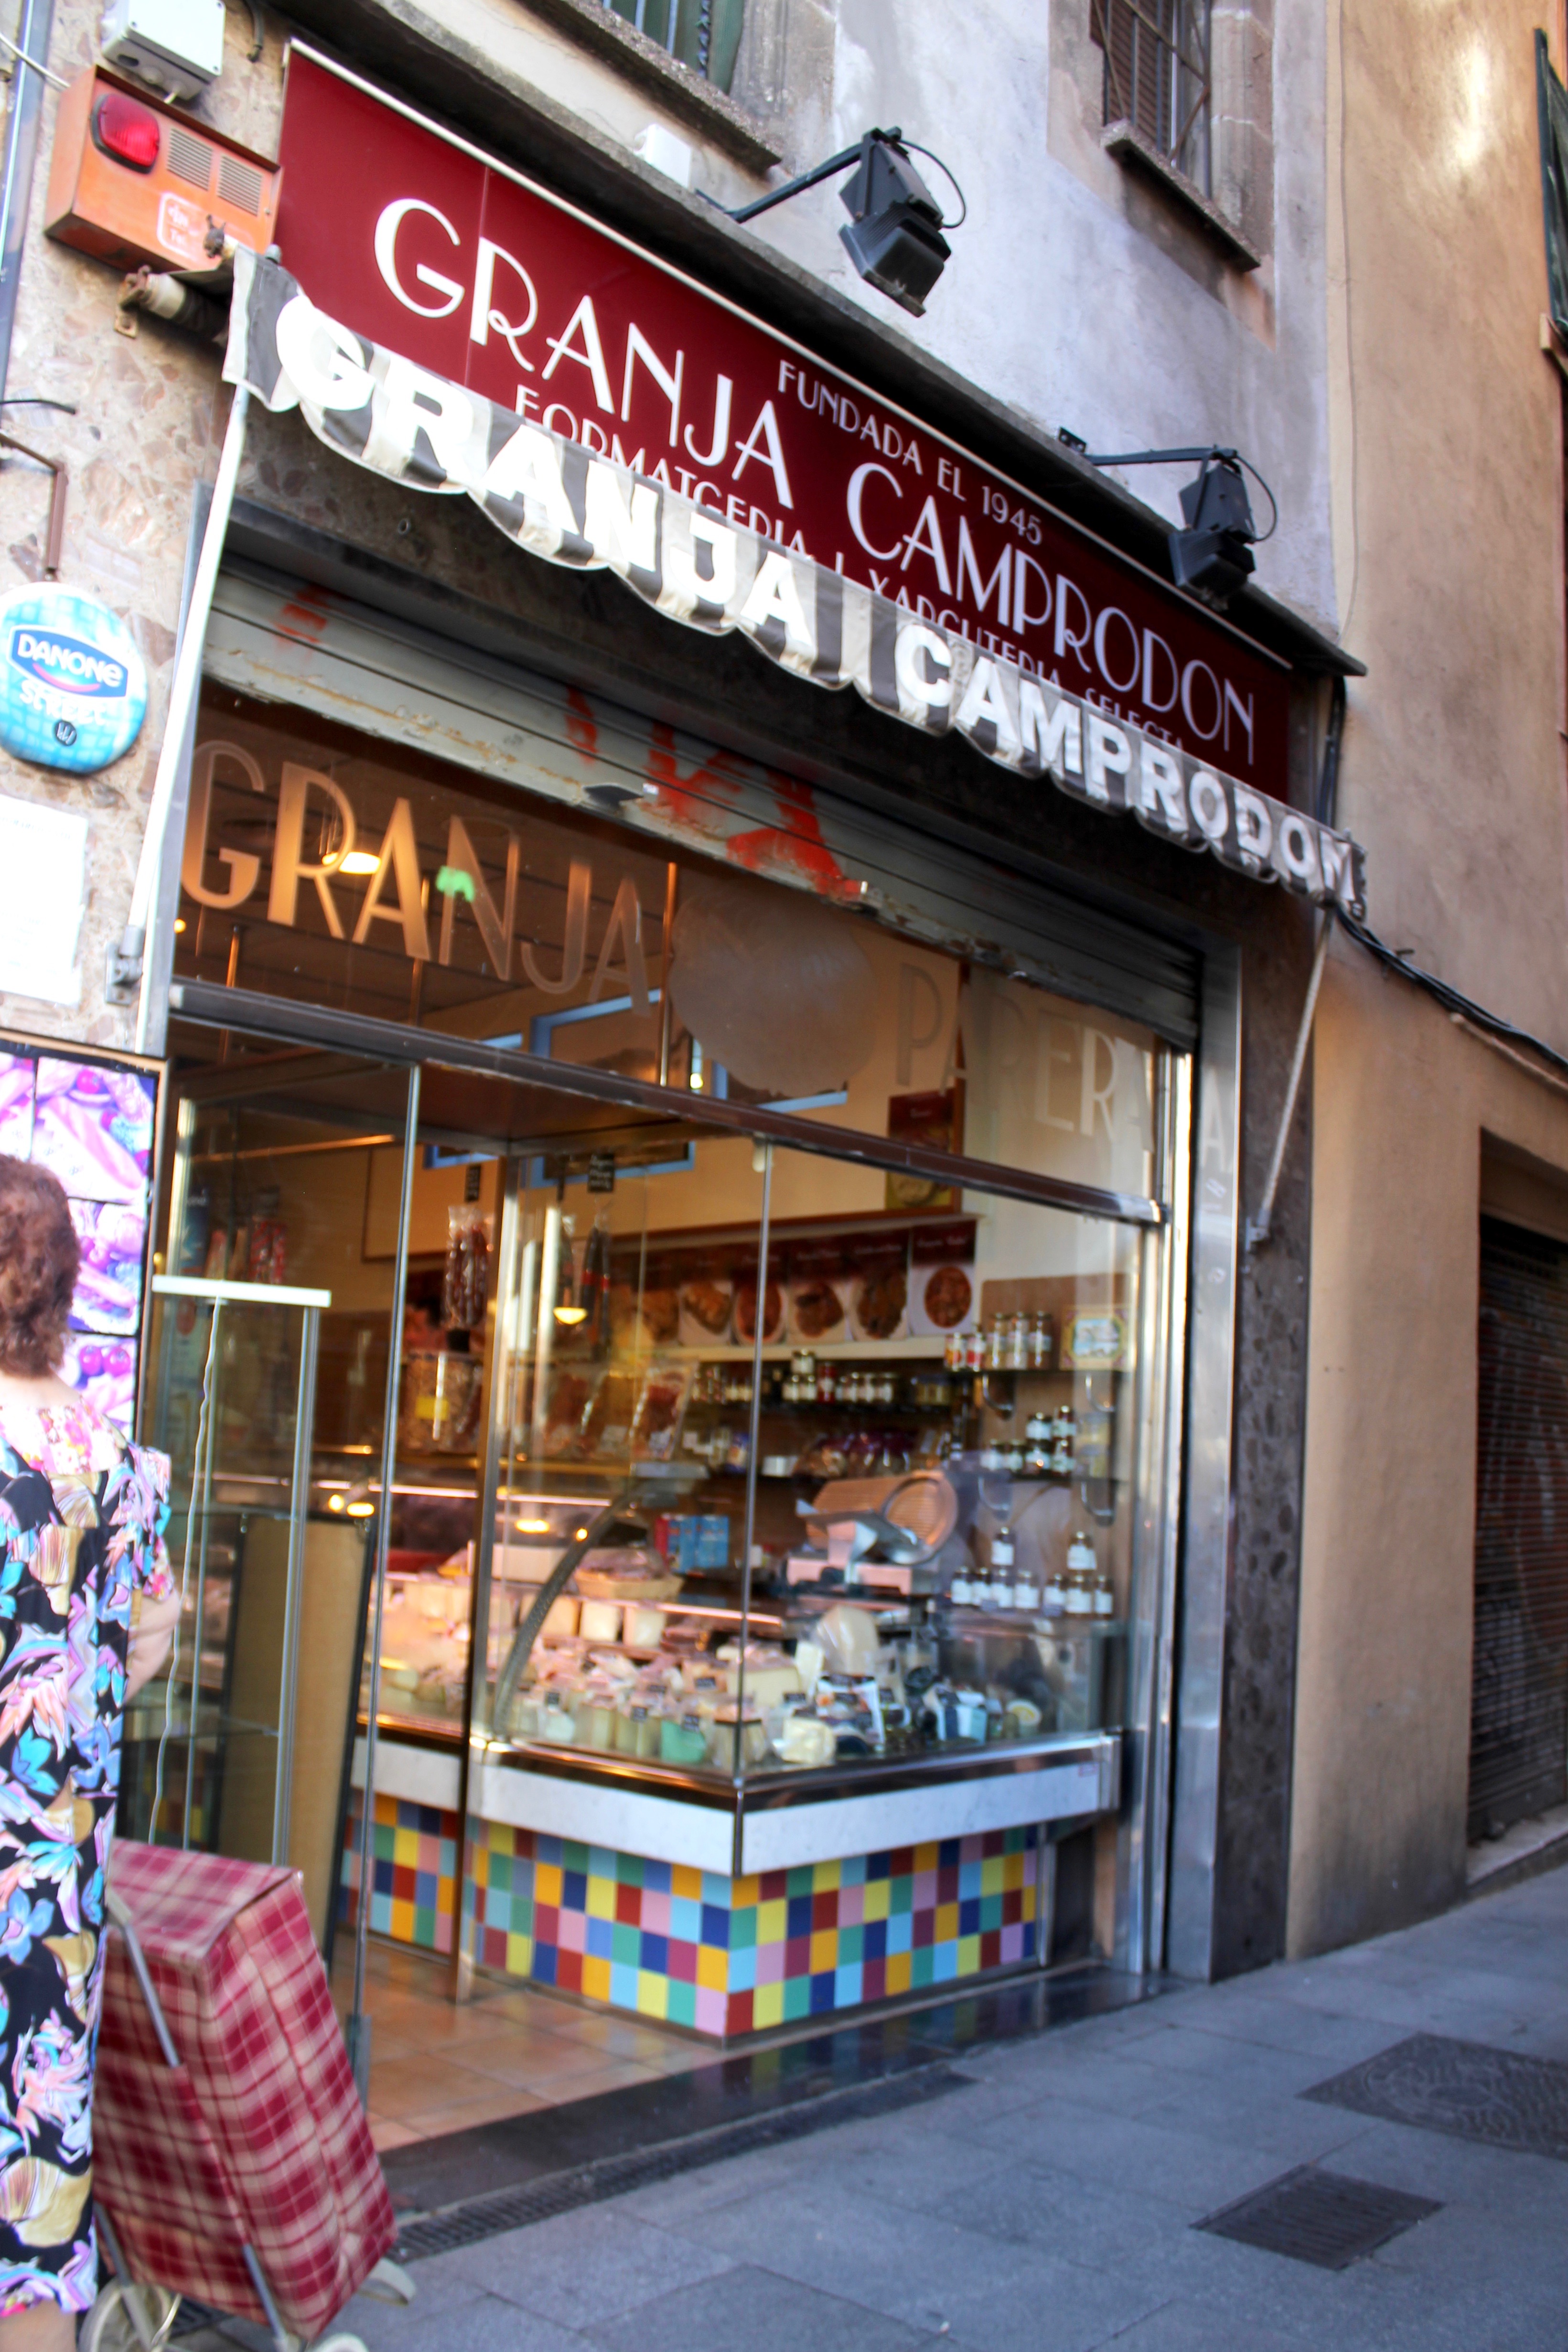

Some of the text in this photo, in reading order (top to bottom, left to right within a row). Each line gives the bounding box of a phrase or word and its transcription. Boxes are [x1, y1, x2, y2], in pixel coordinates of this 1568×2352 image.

[374, 198, 1254, 766] GRANJA CAMPRODON
[778, 359, 1043, 546] FUNDADA EL 1945
[17, 633, 124, 688] DANONE
[275, 293, 1356, 902] GRANJA CAMPRODON
[180, 740, 651, 1019] GRANJA
